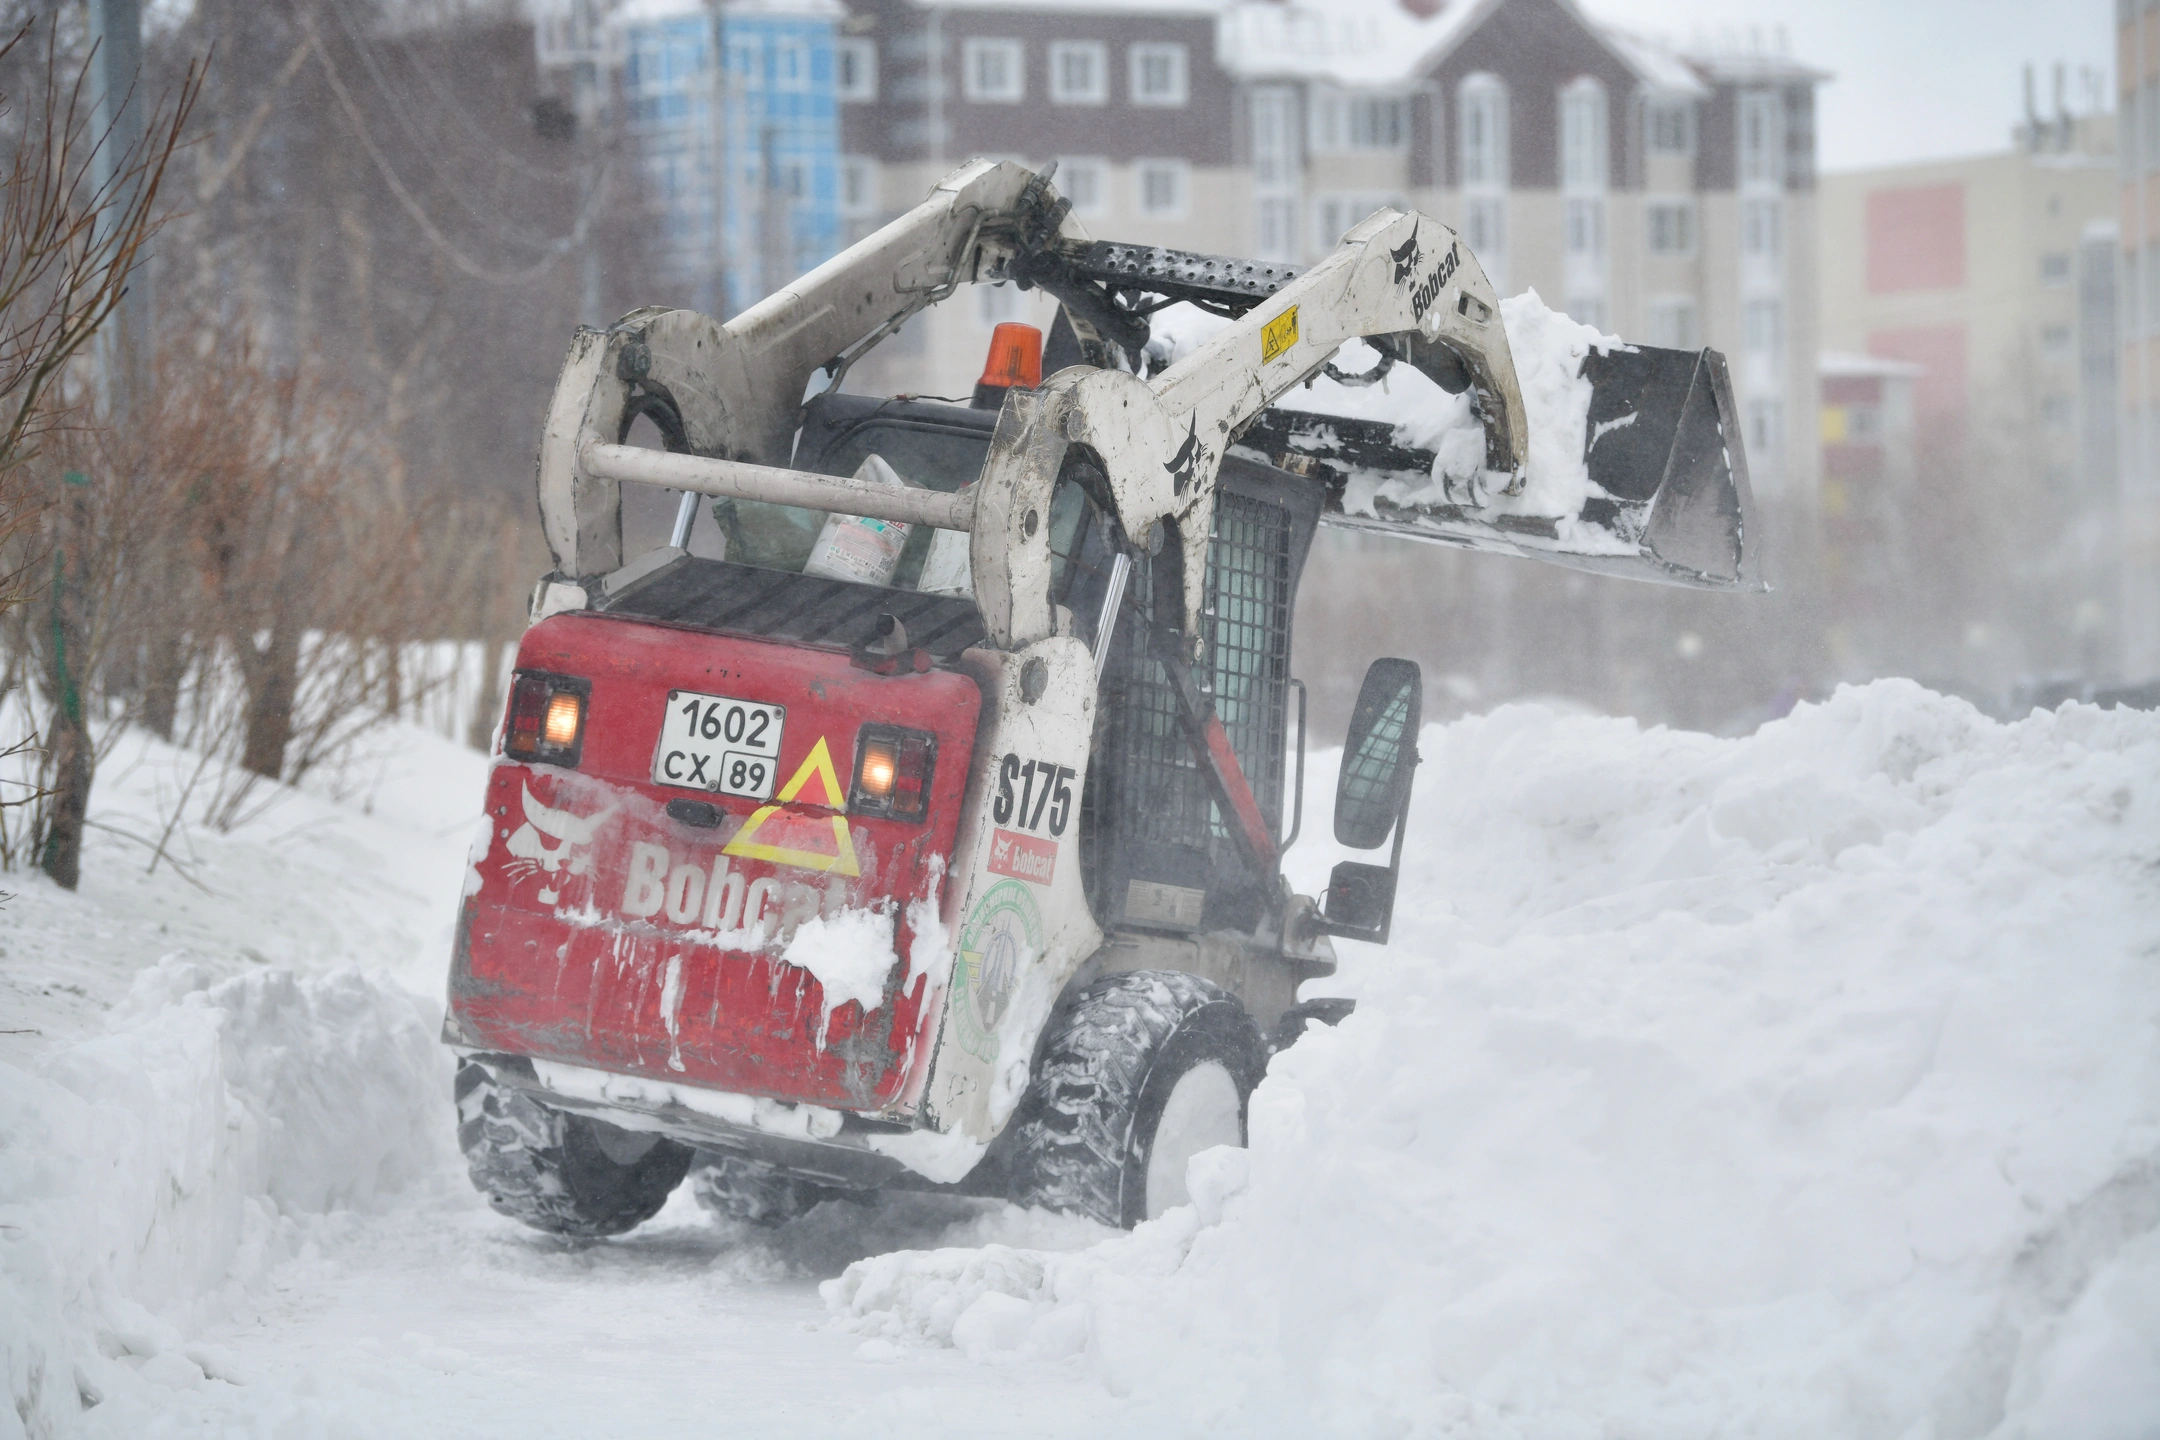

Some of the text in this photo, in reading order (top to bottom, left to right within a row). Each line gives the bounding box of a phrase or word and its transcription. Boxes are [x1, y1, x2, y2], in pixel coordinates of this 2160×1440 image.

[1412, 241, 1460, 324] Bobcat
[682, 699, 770, 748] 1602
[729, 759, 766, 792] 89
[993, 753, 1076, 837] S175
[1012, 846, 1052, 880] Bobcat
